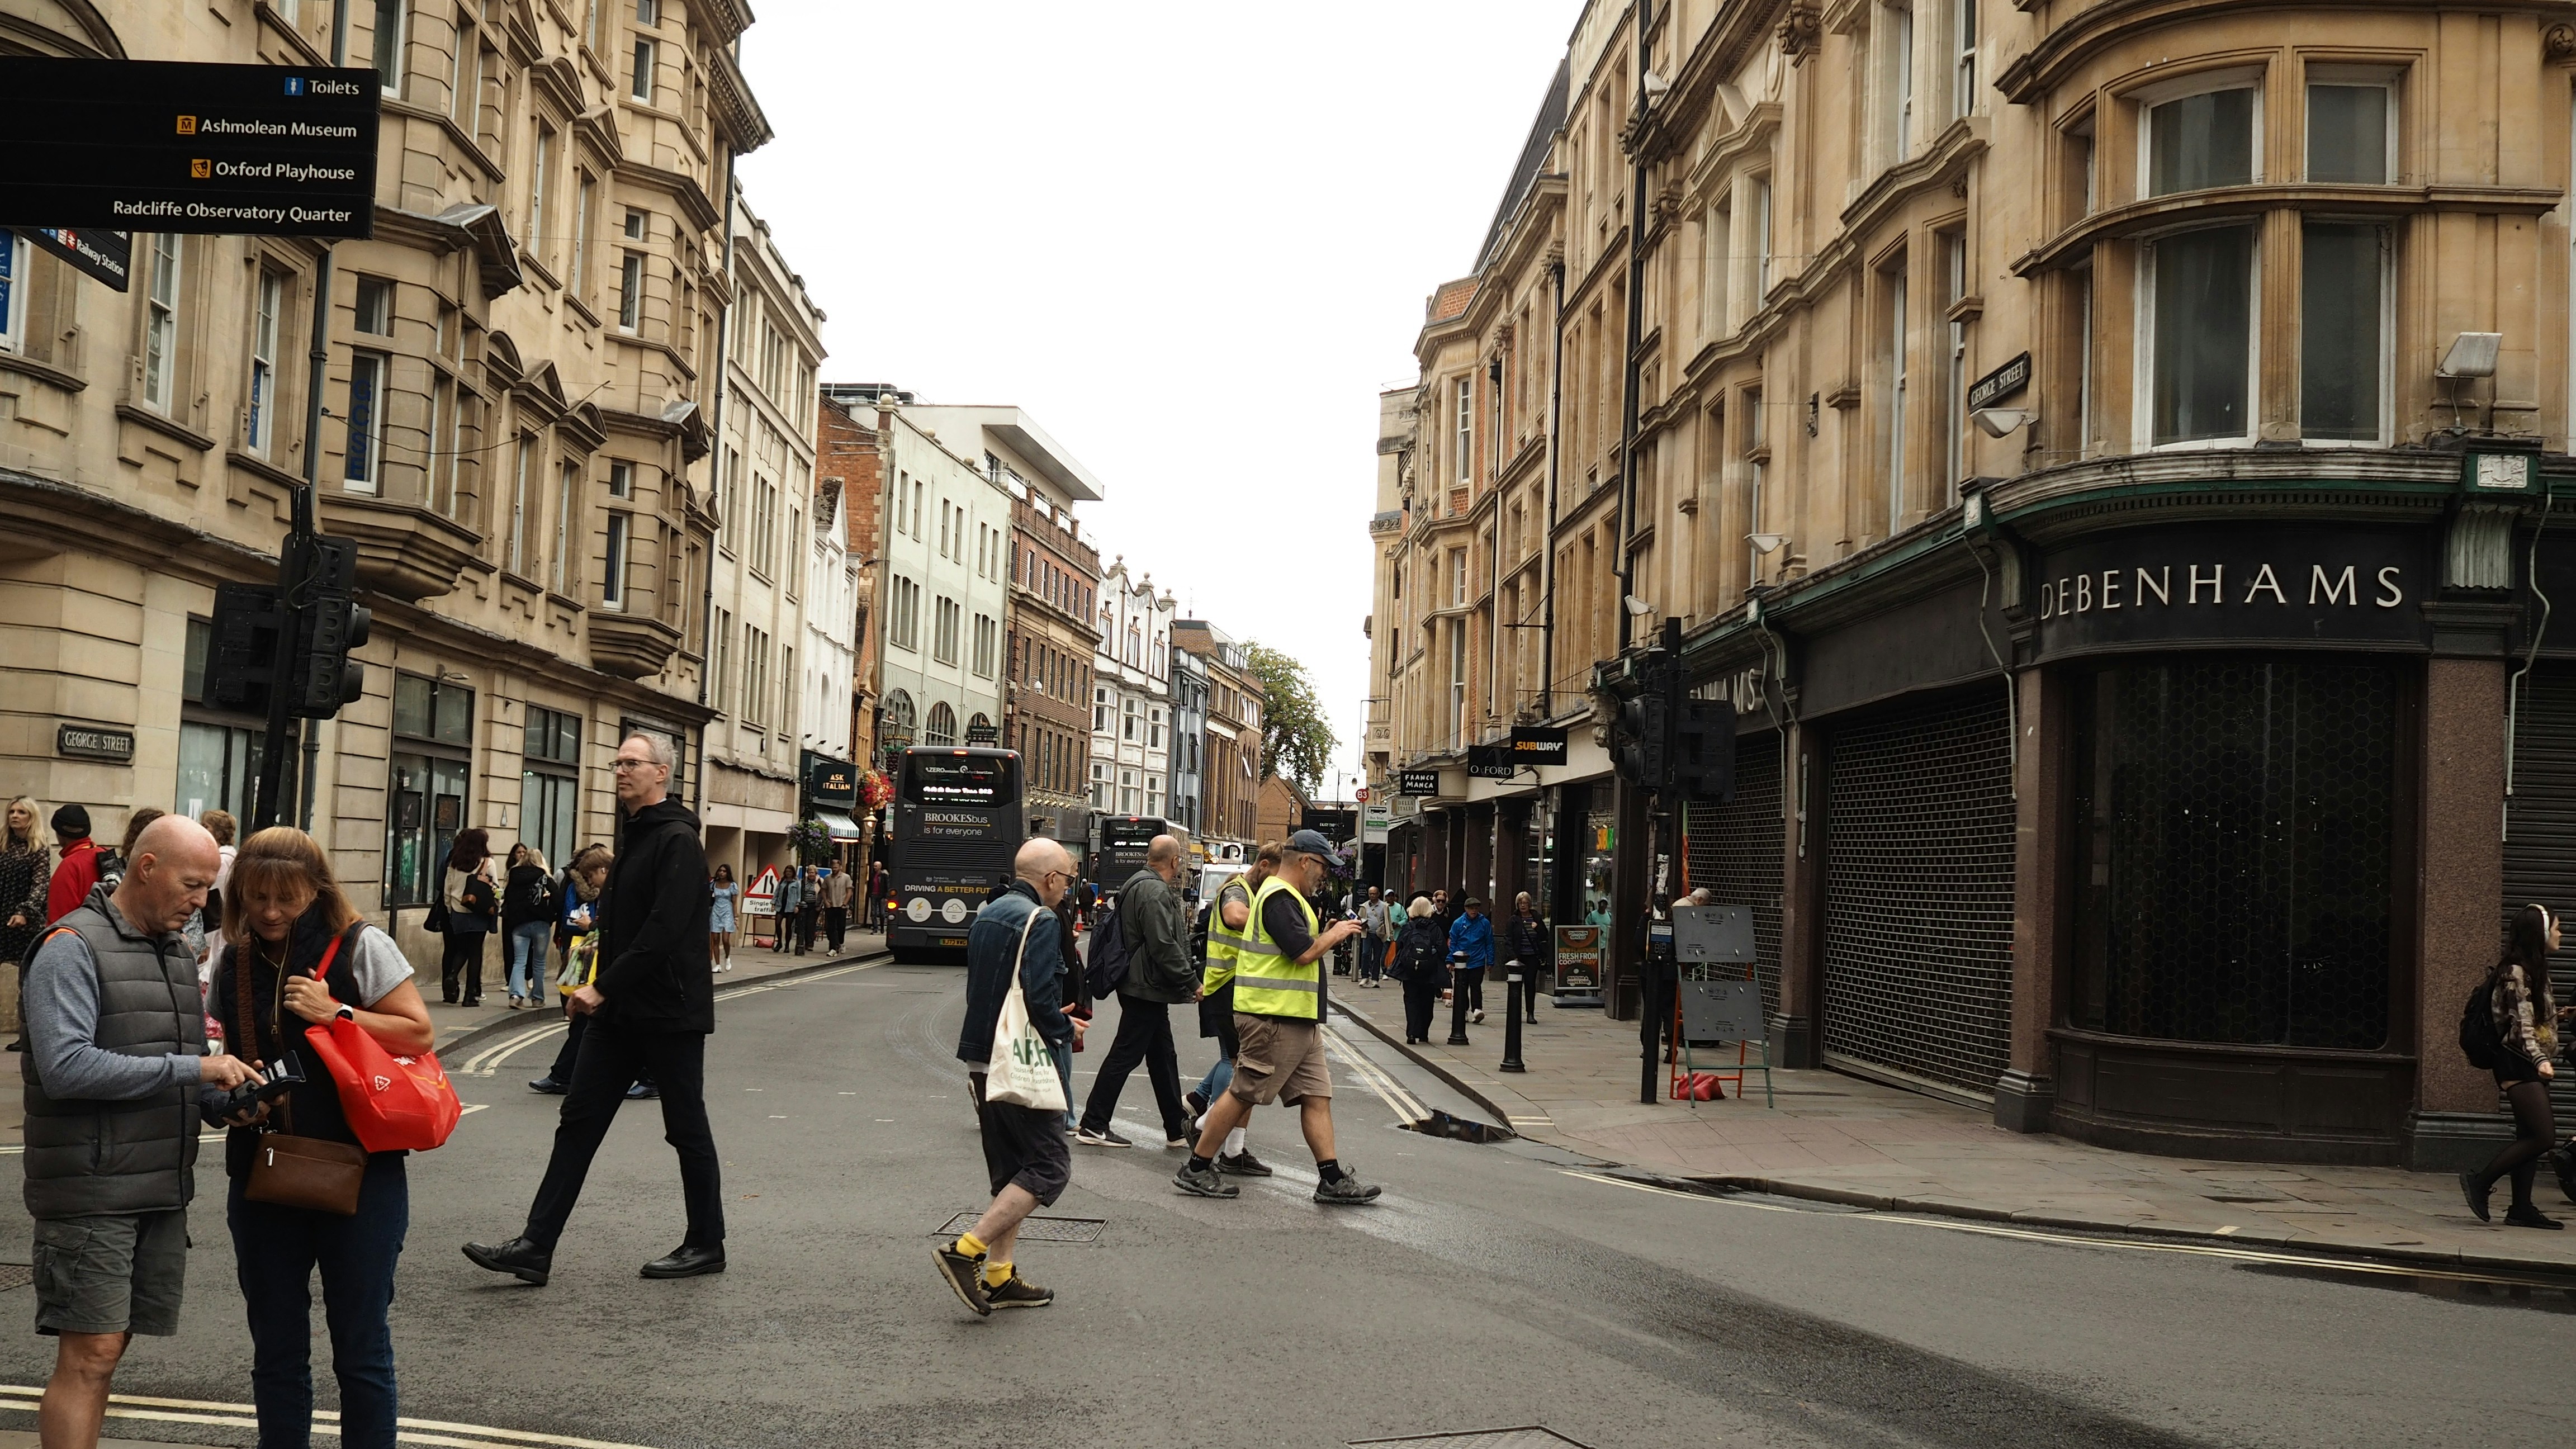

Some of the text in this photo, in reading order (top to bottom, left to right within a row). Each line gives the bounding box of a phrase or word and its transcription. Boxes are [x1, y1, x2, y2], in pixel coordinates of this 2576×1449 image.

[310, 80, 359, 95] Toilets
[201, 119, 357, 138] Ashmolean Museum
[216, 162, 355, 182] Oxford Playhouse
[113, 201, 352, 222] Radcliffe Observatory Quarter
[77, 239, 124, 277] Railway Station
[1971, 362, 2024, 406] GEORGE STREET
[2041, 564, 2402, 620] DEBENHAMS
[65, 731, 129, 752] GEORGE STREET
[1514, 741, 1564, 751] SUBWAY
[925, 813, 988, 823] BROOKESbus
[946, 828, 982, 837] everyone
